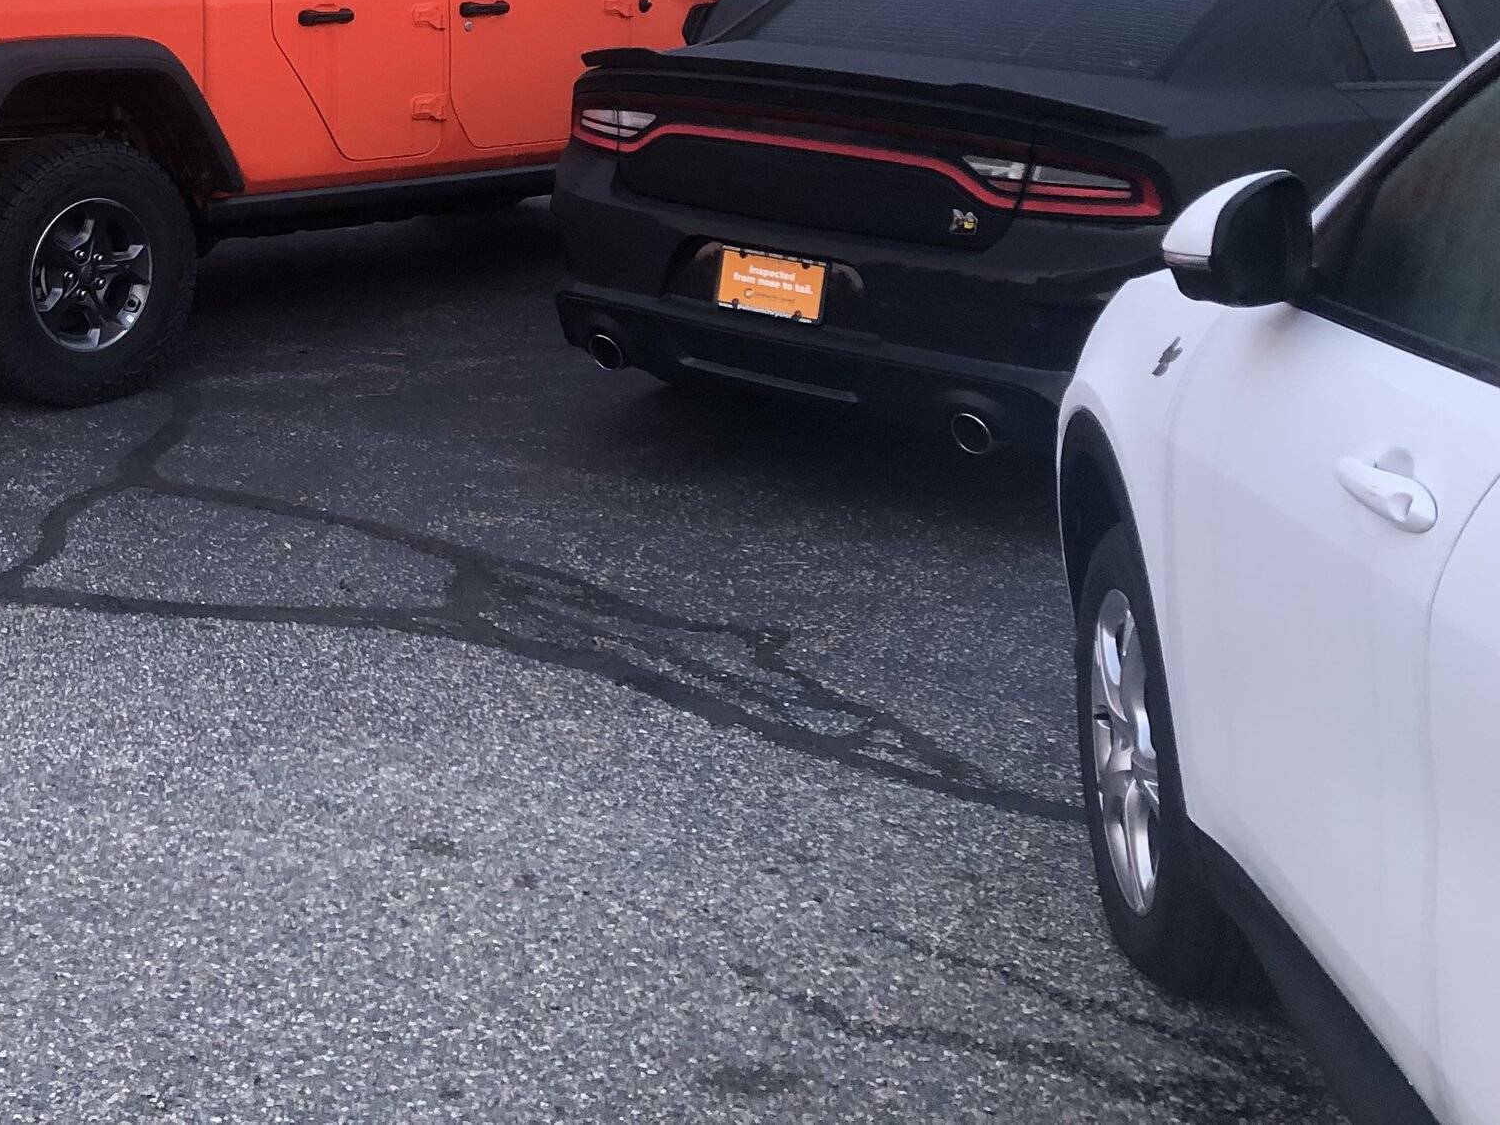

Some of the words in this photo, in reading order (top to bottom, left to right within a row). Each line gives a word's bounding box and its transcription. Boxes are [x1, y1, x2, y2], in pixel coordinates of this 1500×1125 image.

[733, 272, 756, 284] from
[757, 278, 781, 289] nose
[782, 281, 793, 291] to
[749, 264, 796, 281] Inspected
